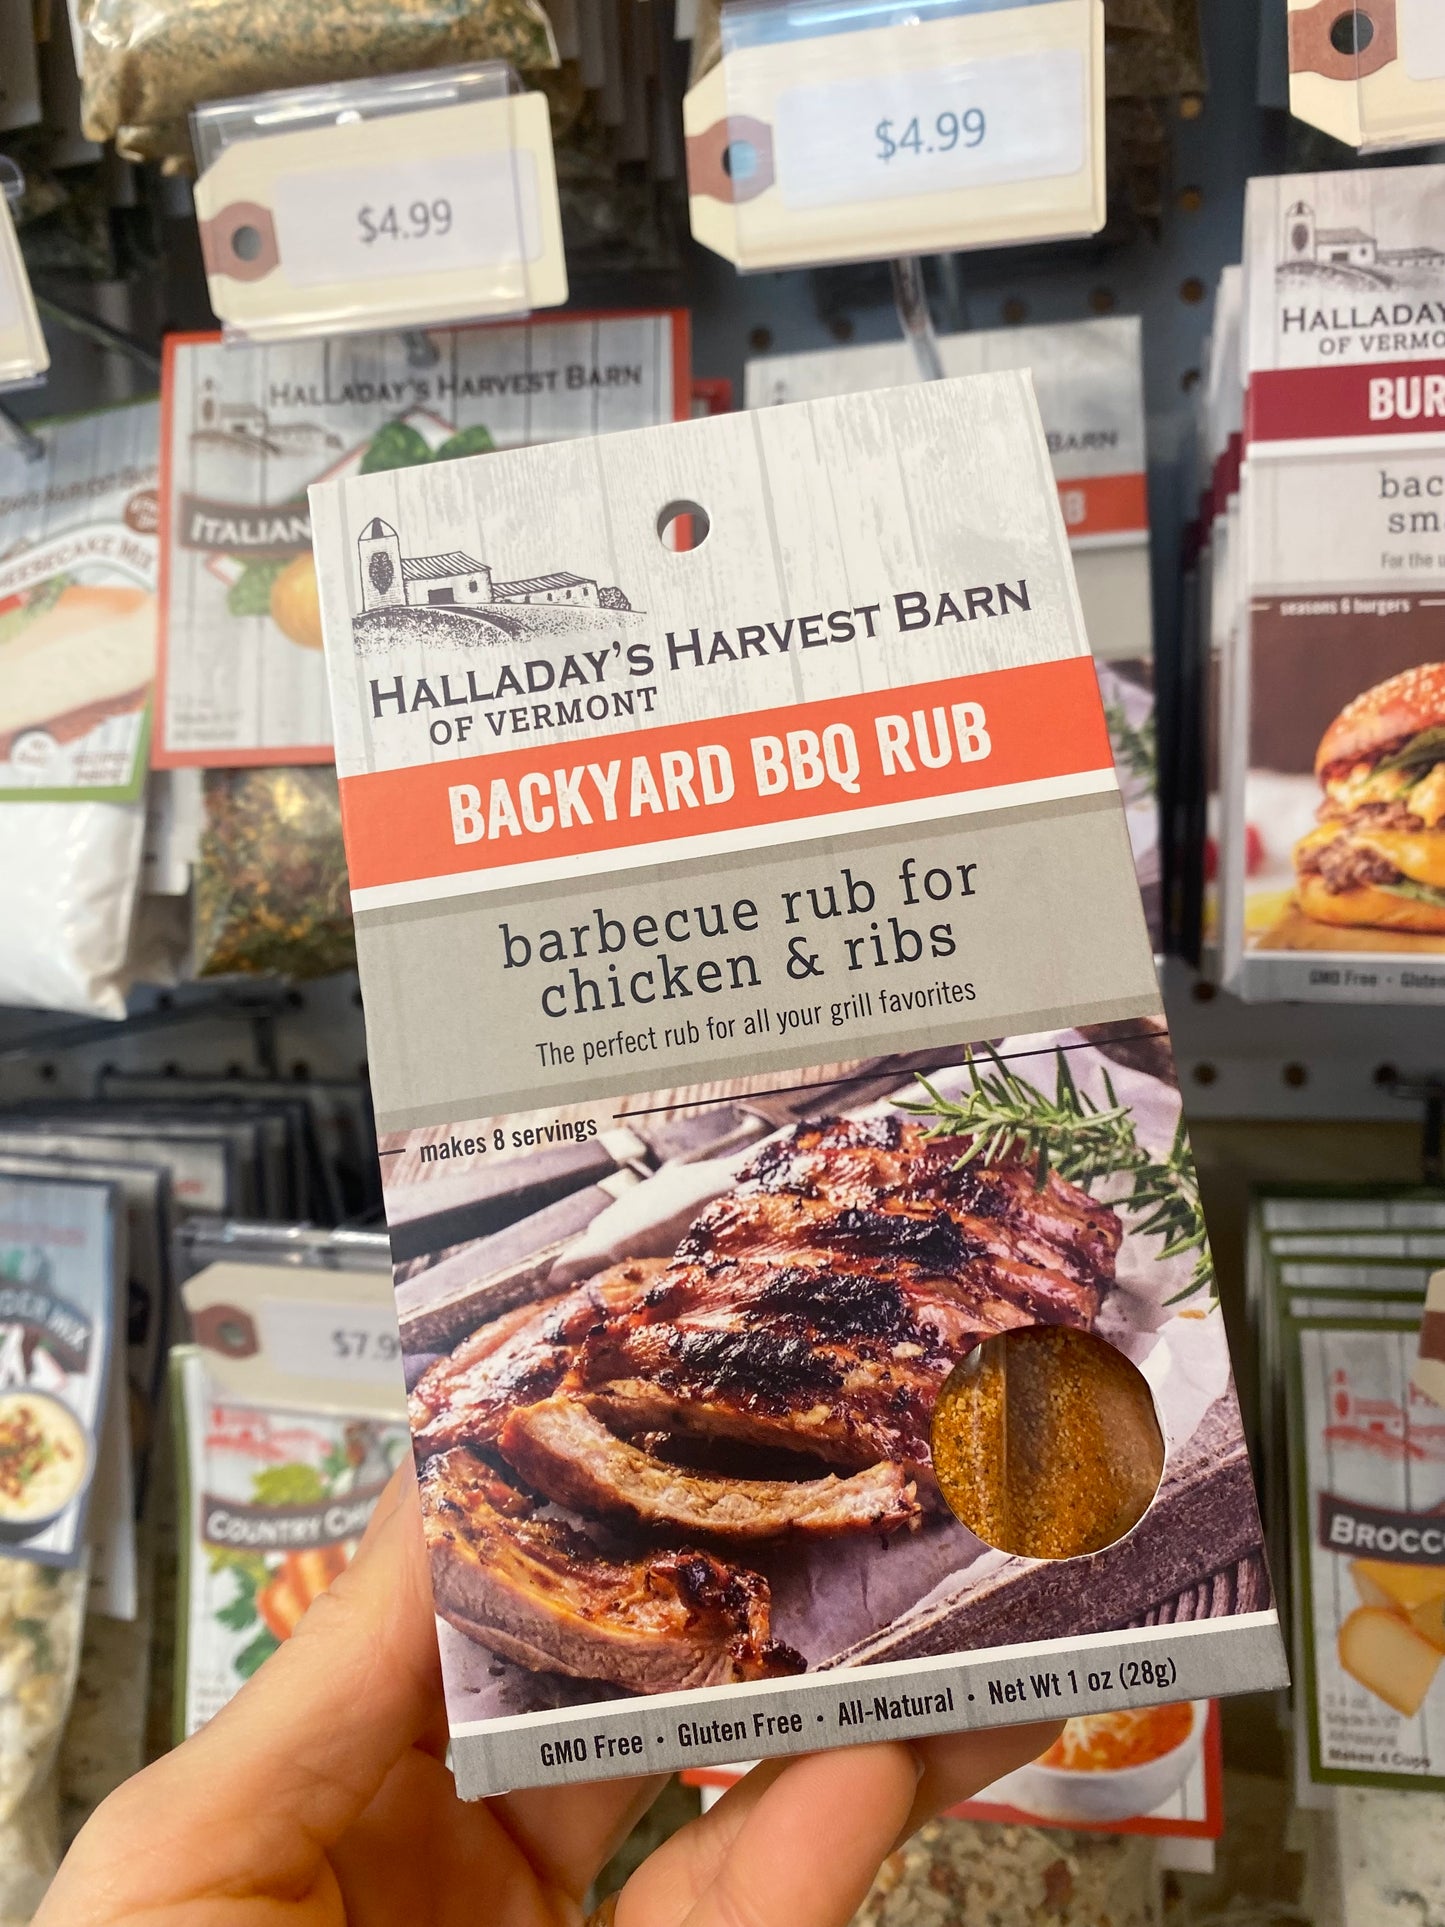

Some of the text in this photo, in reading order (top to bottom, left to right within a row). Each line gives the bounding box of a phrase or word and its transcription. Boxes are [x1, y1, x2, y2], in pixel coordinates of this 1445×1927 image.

[875, 107, 987, 161] $4.99
[357, 199, 453, 245] $4.99
[1318, 335, 1351, 356] OF
[437, 371, 558, 397] HARVEST
[565, 364, 643, 391] BARN
[1368, 374, 1445, 421] BUR
[1379, 470, 1443, 499] bac
[190, 512, 313, 546] ITALIAN
[1408, 551, 1434, 568] the
[1353, 598, 1410, 616] burgers
[369, 579, 1032, 719] HALLADAY'S HARVEST BARN
[429, 686, 658, 746] OF VERMONT
[448, 701, 993, 846] BACKYARD BBQ RUB
[498, 857, 978, 969] barbecue rub for
[540, 917, 957, 1018] chicken & ribs
[1343, 970, 1376, 987] Free
[536, 982, 977, 1067] The perfect rub for all your grill favorites
[419, 1118, 598, 1163] makes 8 servings
[331, 1327, 400, 1360] $7.9
[1330, 1514, 1445, 1555] BROCC
[540, 1657, 1177, 1767] GMO Free Gluten Free All-Natural Net Wt 1 oz (28g)
[1391, 1753, 1430, 1768] Cups
